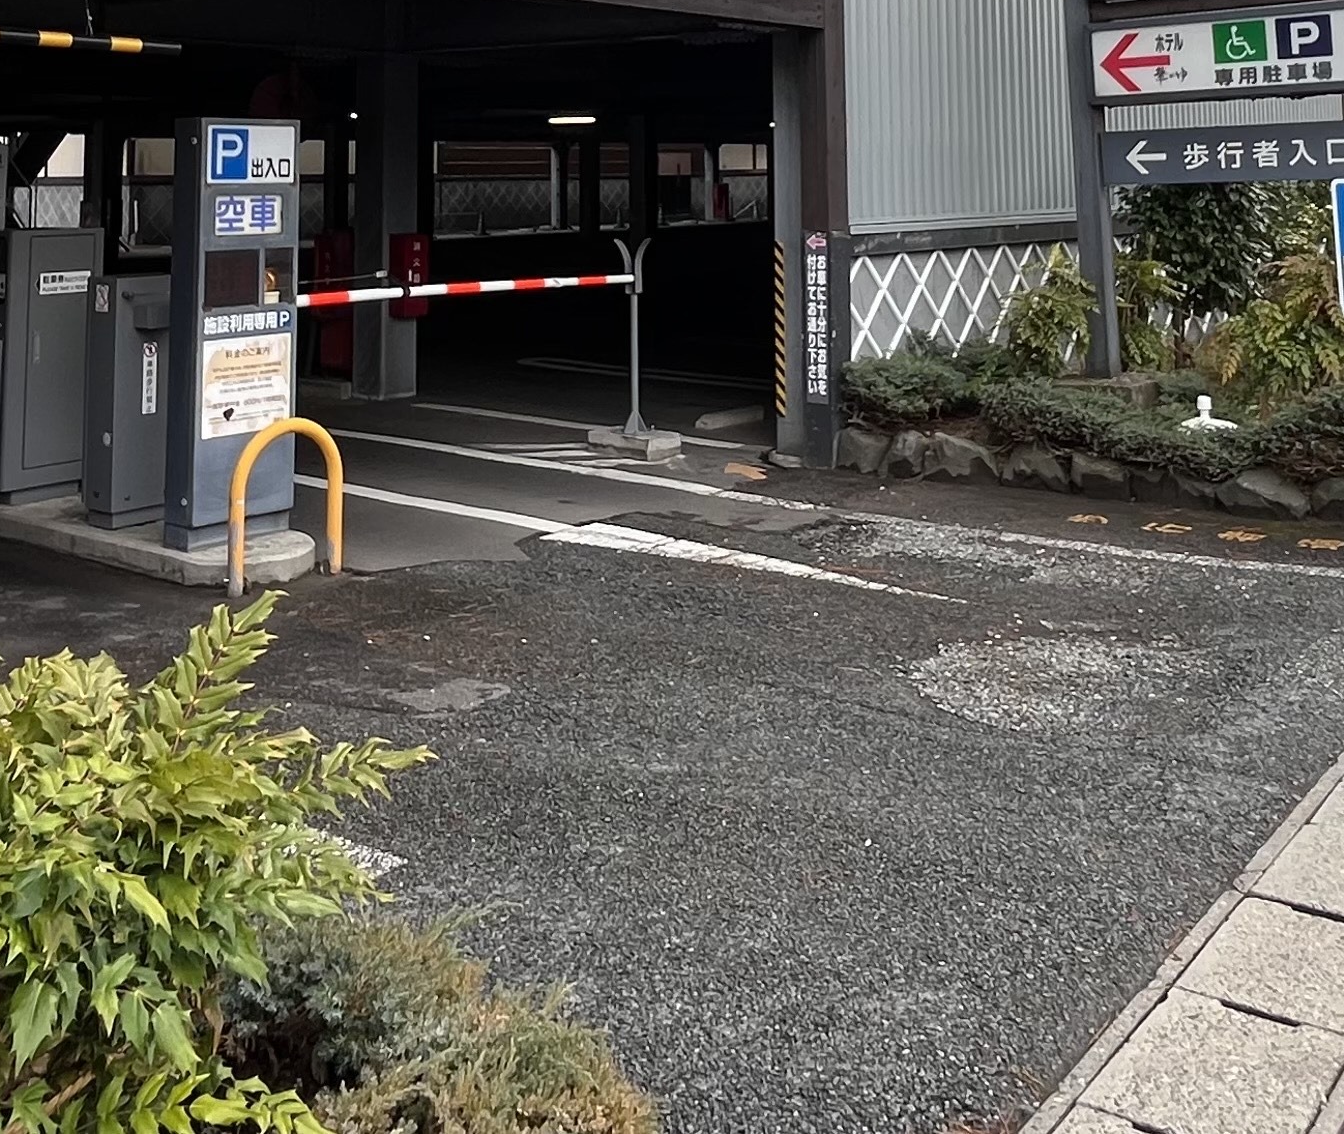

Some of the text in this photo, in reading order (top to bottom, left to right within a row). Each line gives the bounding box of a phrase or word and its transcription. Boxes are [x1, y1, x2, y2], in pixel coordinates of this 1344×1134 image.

[1155, 32, 1183, 53] ホテル
[1290, 21, 1320, 55] P
[1214, 60, 1333, 86] 専用駐車場
[216, 133, 291, 178] P 出入口
[216, 195, 277, 232] 空車
